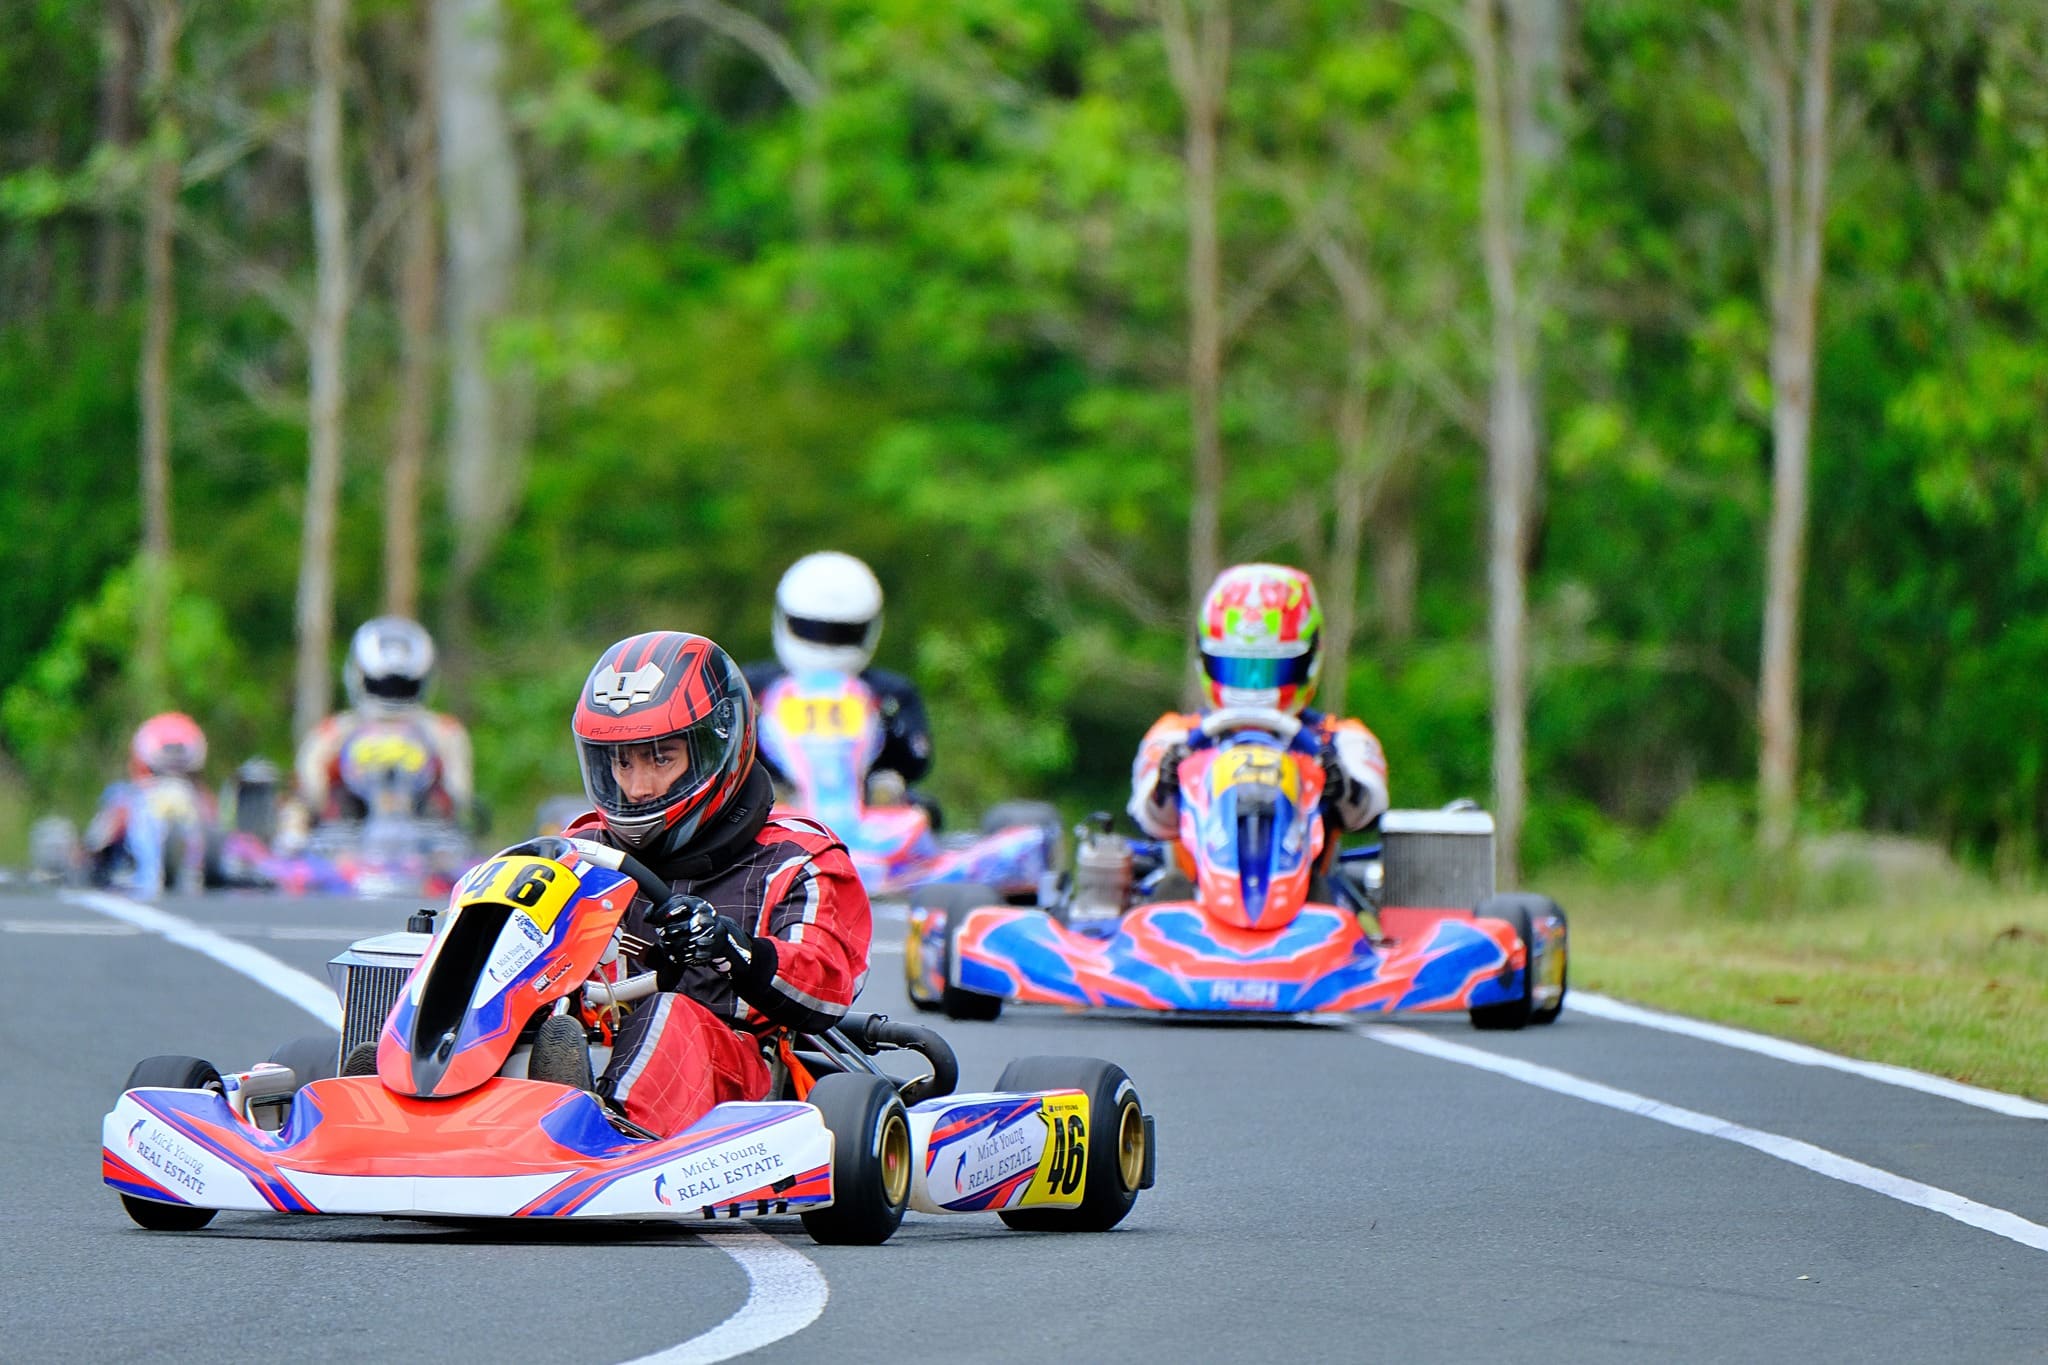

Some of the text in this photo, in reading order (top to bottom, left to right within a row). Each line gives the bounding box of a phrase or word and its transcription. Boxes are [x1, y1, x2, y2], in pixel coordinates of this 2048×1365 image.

[465, 861, 556, 907] 46
[149, 1128, 204, 1175] Mick Young
[682, 1142, 767, 1179] Mick Young
[968, 1145, 1033, 1190] REAL ESTATE
[977, 1127, 1025, 1162] Mick Young
[1047, 1115, 1086, 1195] 46
[136, 1142, 206, 1195] REAL ESTATE
[677, 1154, 784, 1201] REAL ESTATE
